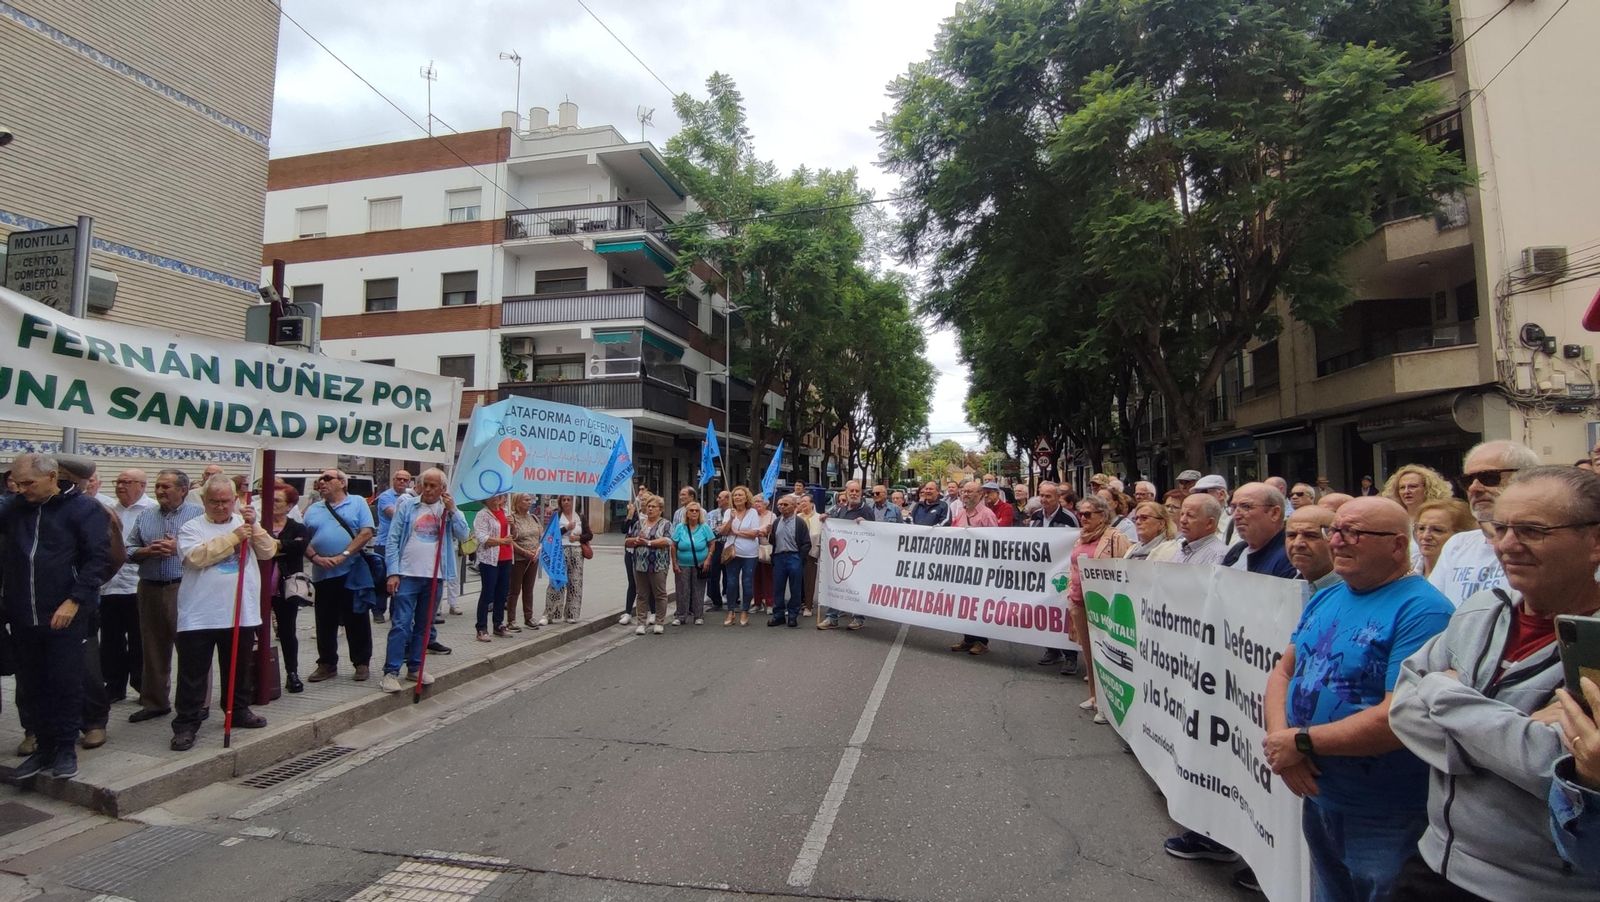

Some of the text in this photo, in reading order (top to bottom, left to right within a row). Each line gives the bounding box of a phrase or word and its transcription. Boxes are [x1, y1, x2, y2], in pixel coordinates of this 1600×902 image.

[15, 234, 70, 249] MONTILLA
[23, 255, 59, 268] CENTRO
[15, 267, 66, 280] COMERCIAL
[20, 280, 58, 292] ABIERTO
[17, 313, 432, 412] FERNÁN NÚÑEZ POR
[107, 387, 307, 439] SANIDAD
[315, 411, 446, 452] PÚBLICA
[520, 424, 577, 443] SANIDAD
[897, 535, 1052, 563] PLATAFORMA EN DEFENSA
[895, 560, 1046, 593] DE LA SANIDAD PÚBLICA
[1453, 566, 1474, 582] THE
[868, 584, 956, 617] MONTALBÁN
[958, 595, 979, 621] DE
[1210, 715, 1272, 794] Pública
